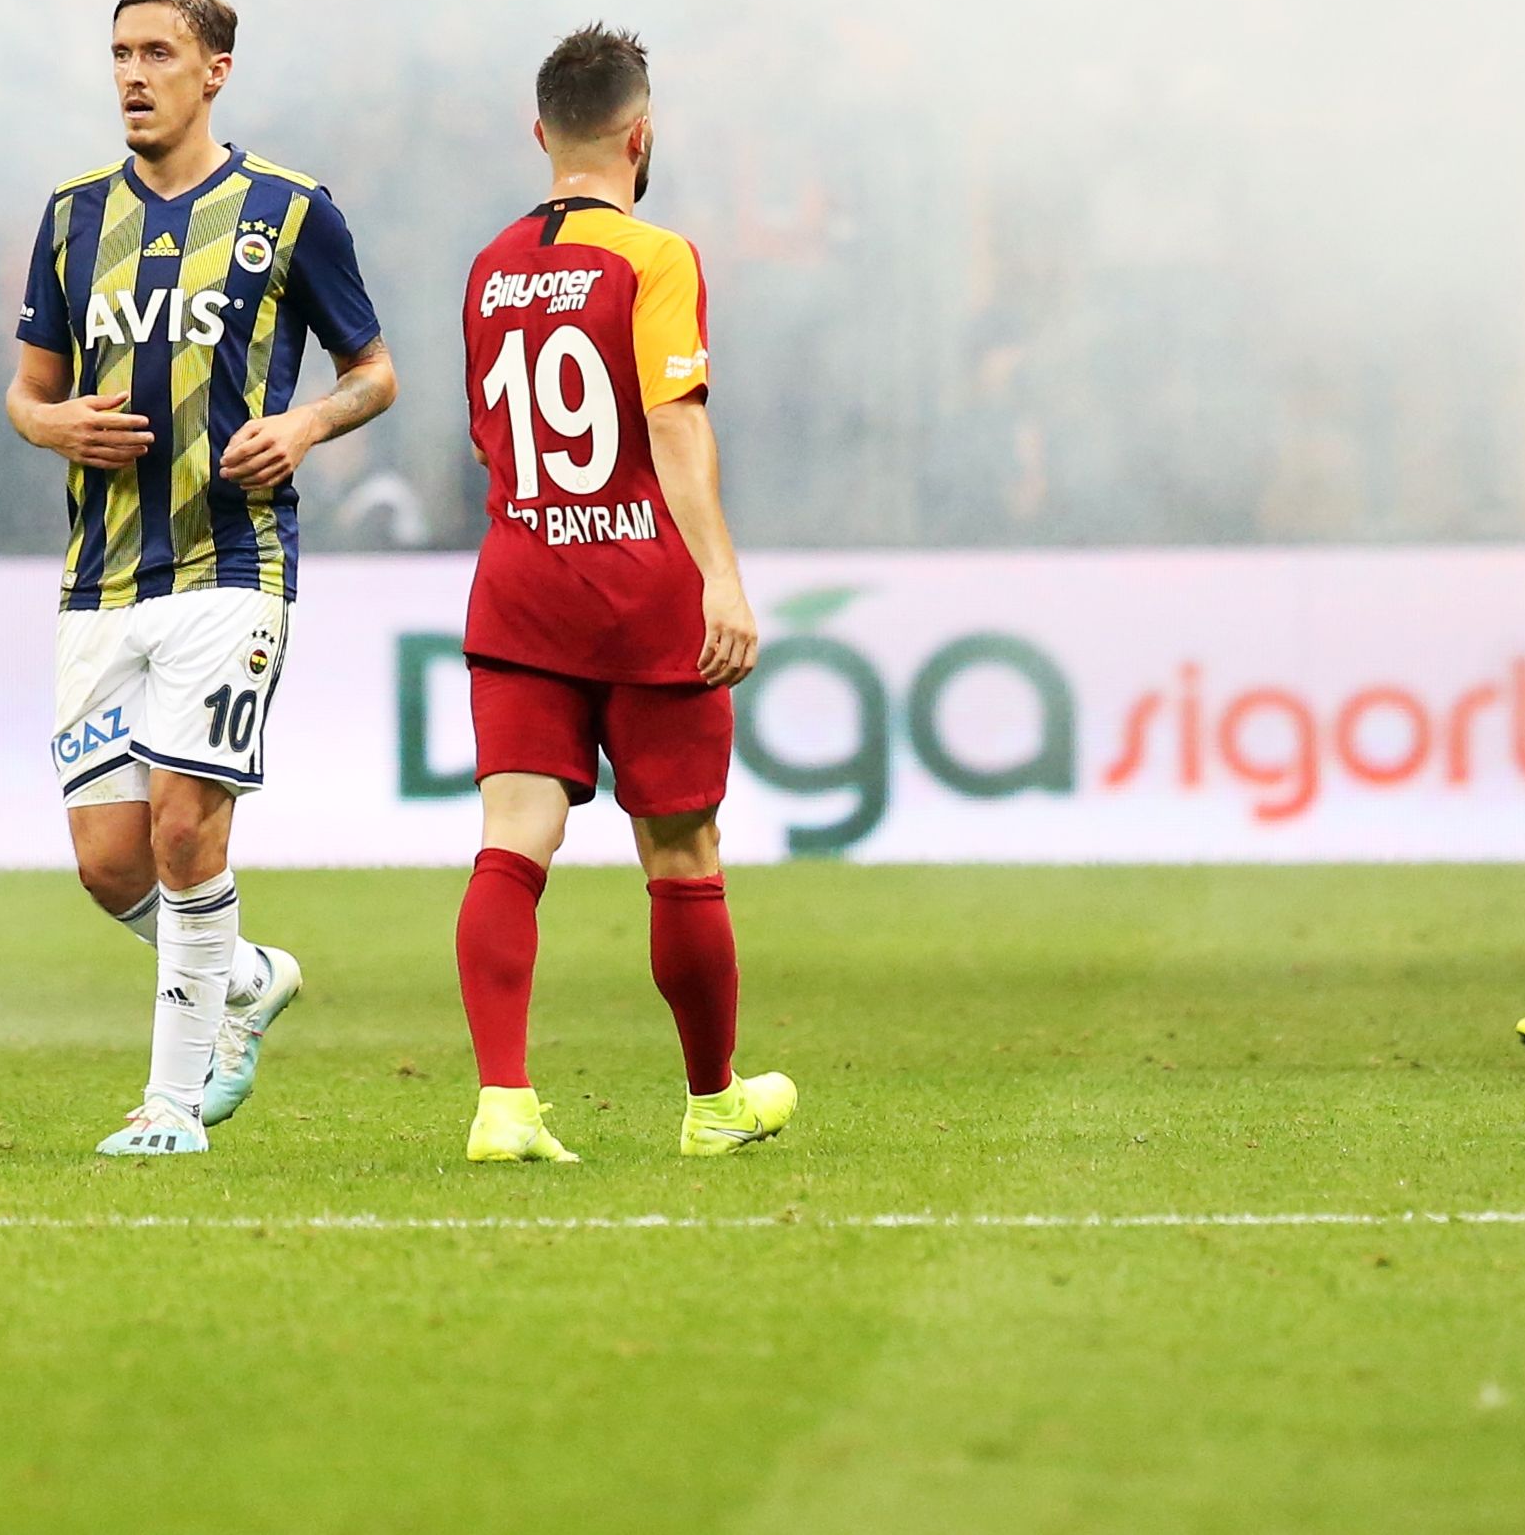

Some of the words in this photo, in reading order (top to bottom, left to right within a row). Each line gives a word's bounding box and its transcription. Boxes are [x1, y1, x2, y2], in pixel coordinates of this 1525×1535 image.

[85, 288, 231, 350] AVIS
[479, 269, 603, 318] Bilyoner
[482, 324, 620, 501] 19
[545, 499, 657, 546] BAYRAM
[204, 683, 257, 753] 10
